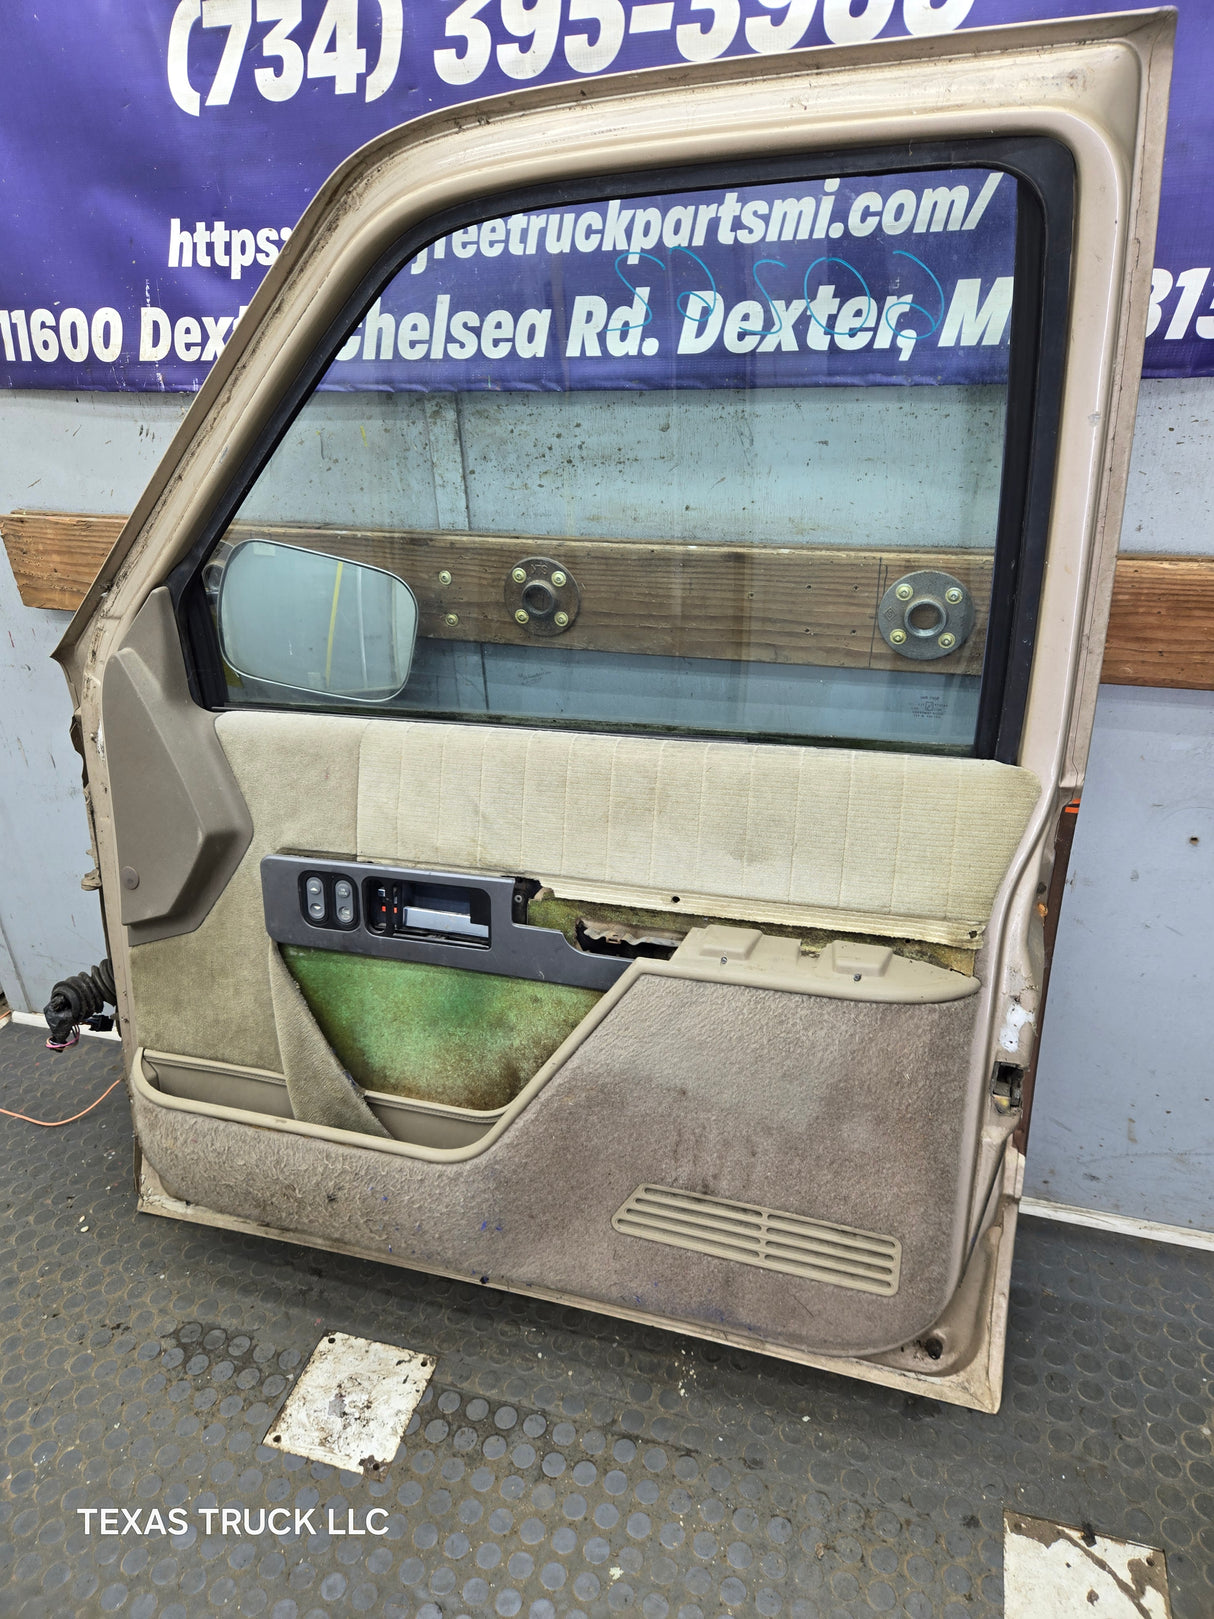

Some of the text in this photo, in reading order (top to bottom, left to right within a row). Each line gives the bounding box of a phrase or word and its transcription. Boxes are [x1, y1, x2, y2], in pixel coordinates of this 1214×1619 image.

[167, 0, 403, 117] (734)
[0, 307, 123, 363] 11600
[565, 286, 660, 362] Rd.
[677, 284, 915, 362] Dexter,
